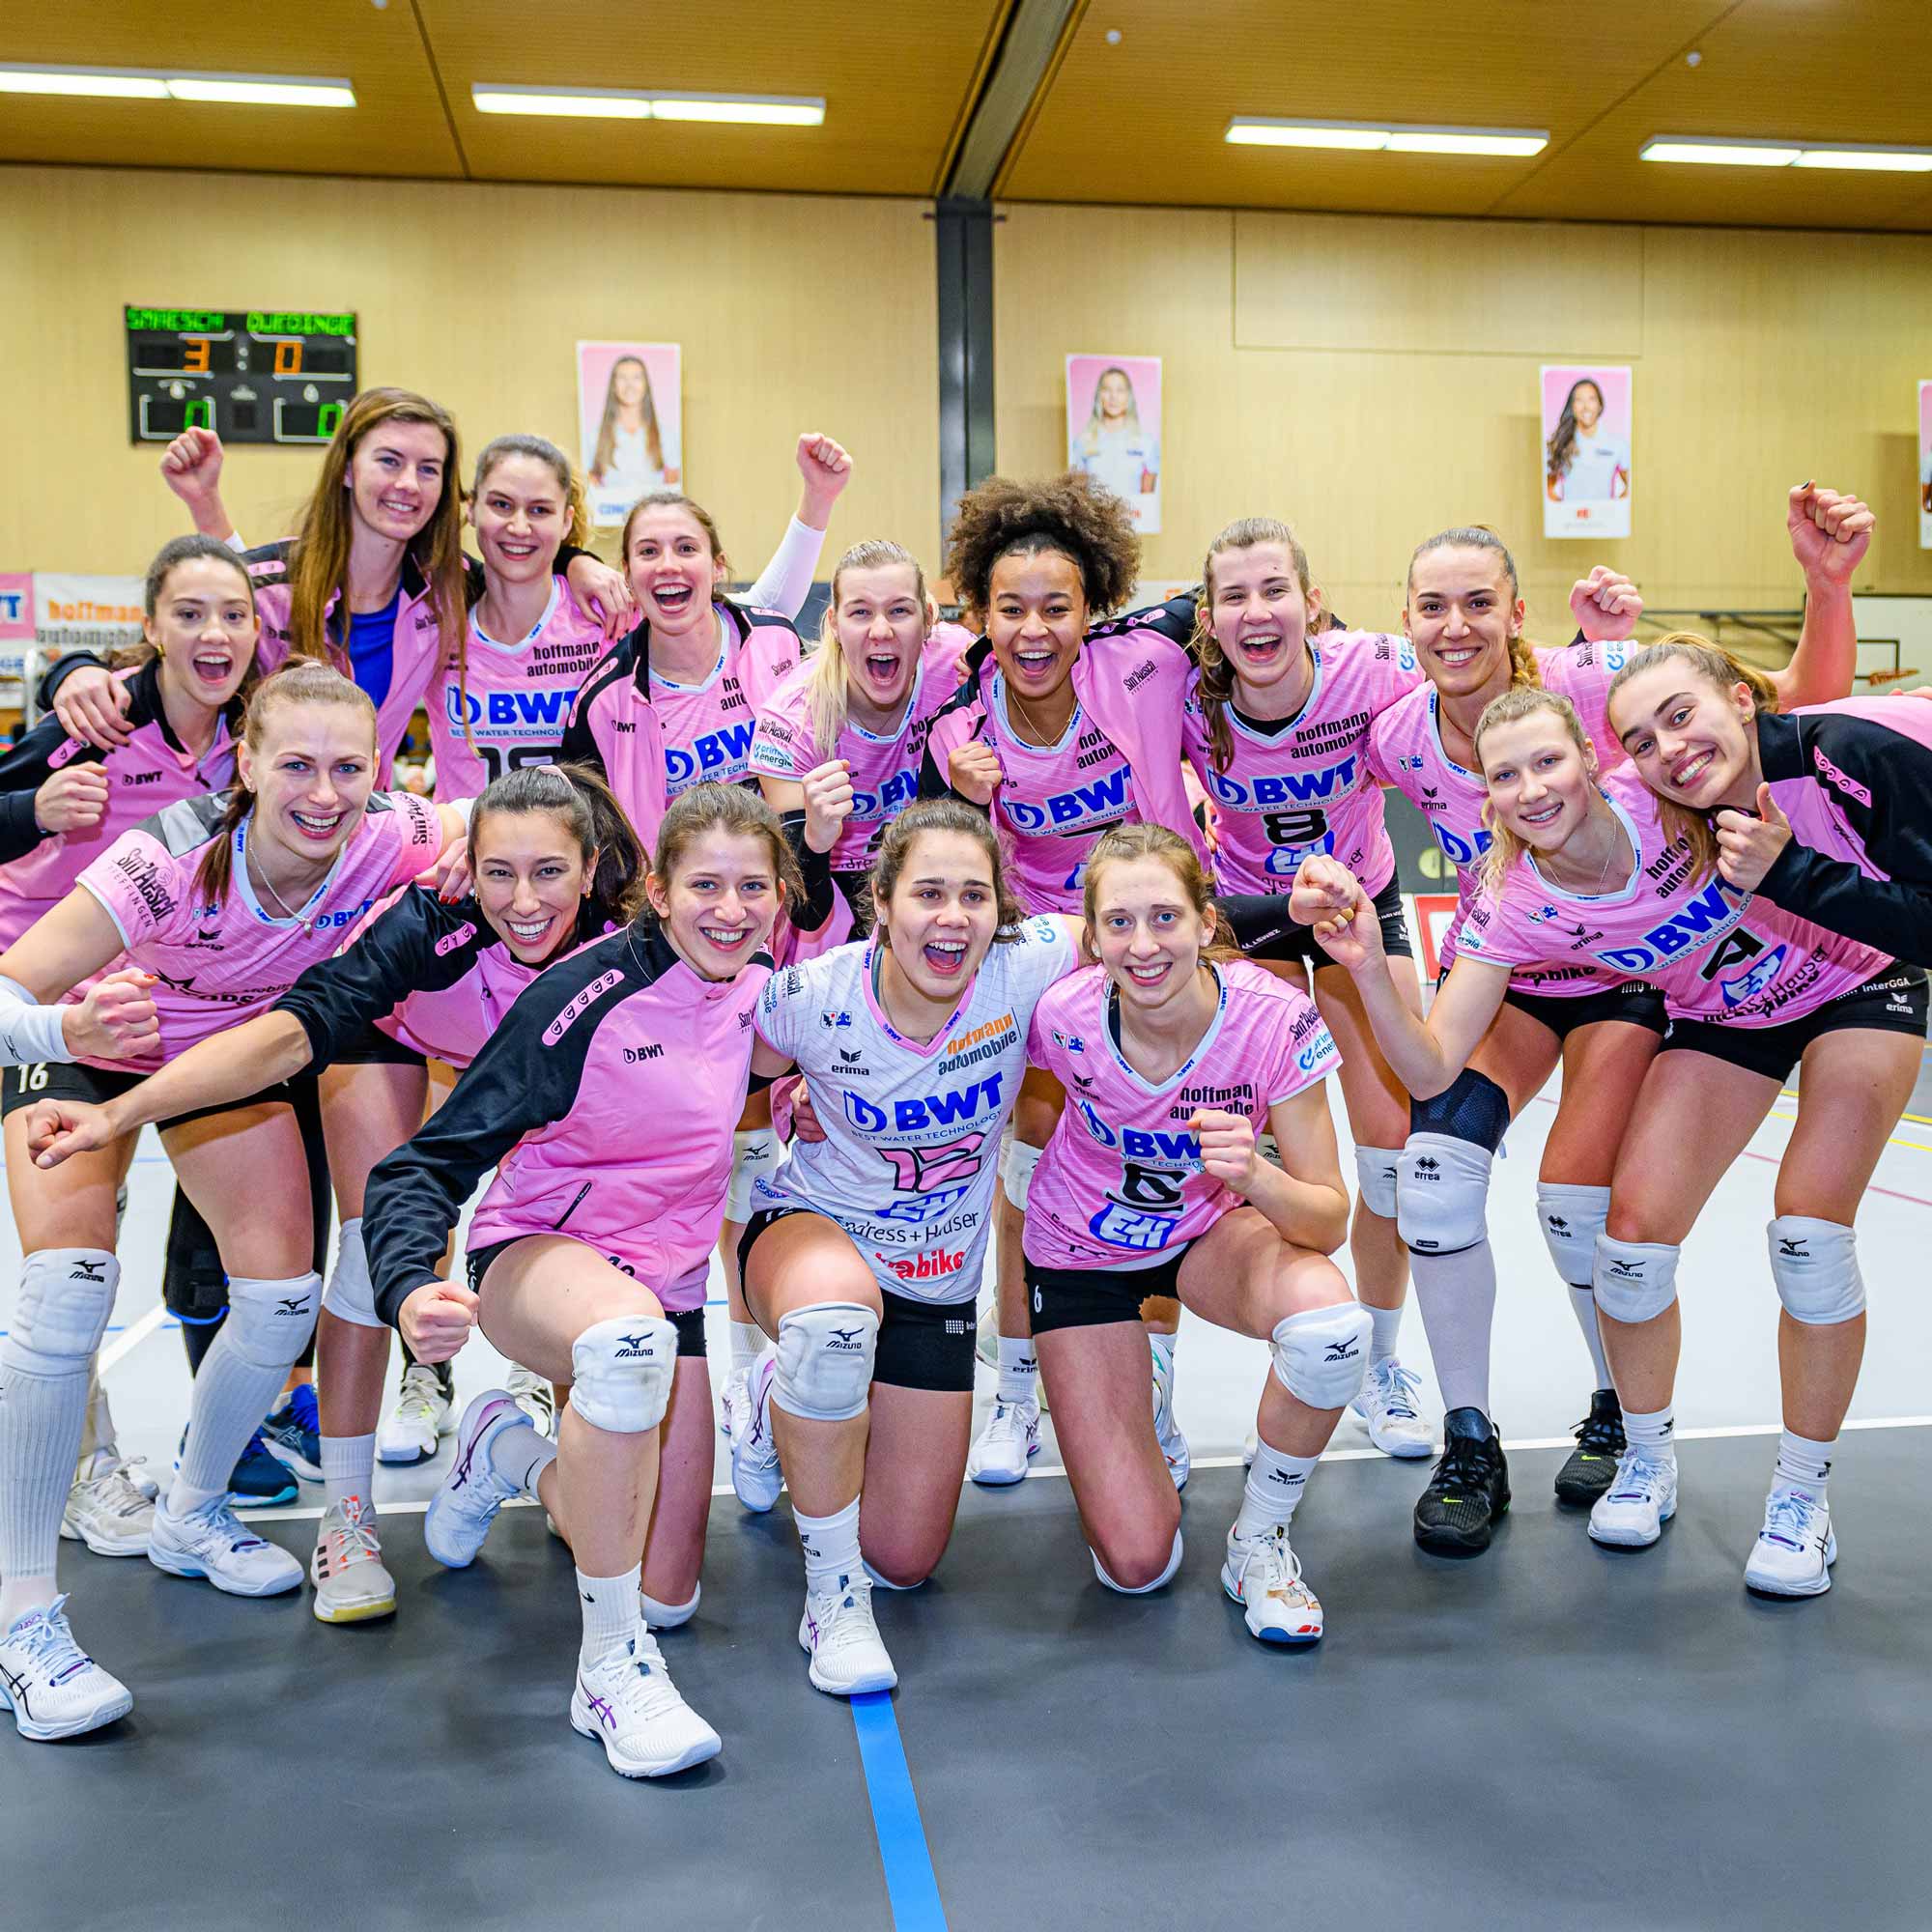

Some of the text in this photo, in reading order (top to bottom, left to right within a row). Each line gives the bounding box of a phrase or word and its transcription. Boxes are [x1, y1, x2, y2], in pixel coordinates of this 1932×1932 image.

[184, 340, 211, 373] 3
[274, 341, 302, 374] 0
[317, 403, 344, 438] 0
[1295, 710, 1370, 744] hoffmann
[134, 771, 163, 785] BWT
[1253, 755, 1357, 806] BWT
[1284, 782, 1356, 810] TECHNOLOGY
[1421, 800, 1447, 810] erima
[1263, 809, 1329, 846] 8
[1570, 931, 1605, 952] erima
[1887, 1003, 1915, 1014] erima
[887, 1025, 902, 1043] BWT
[638, 1043, 665, 1062] BWT
[938, 1030, 1018, 1076] automobile
[17, 1062, 49, 1094] 16
[831, 1064, 870, 1076] erima
[1119, 1060, 1133, 1075] BWT
[894, 1070, 1004, 1132] BWT
[880, 1134, 923, 1143] WATER
[1414, 1171, 1441, 1182] errea
[1033, 1284, 1044, 1314] 6
